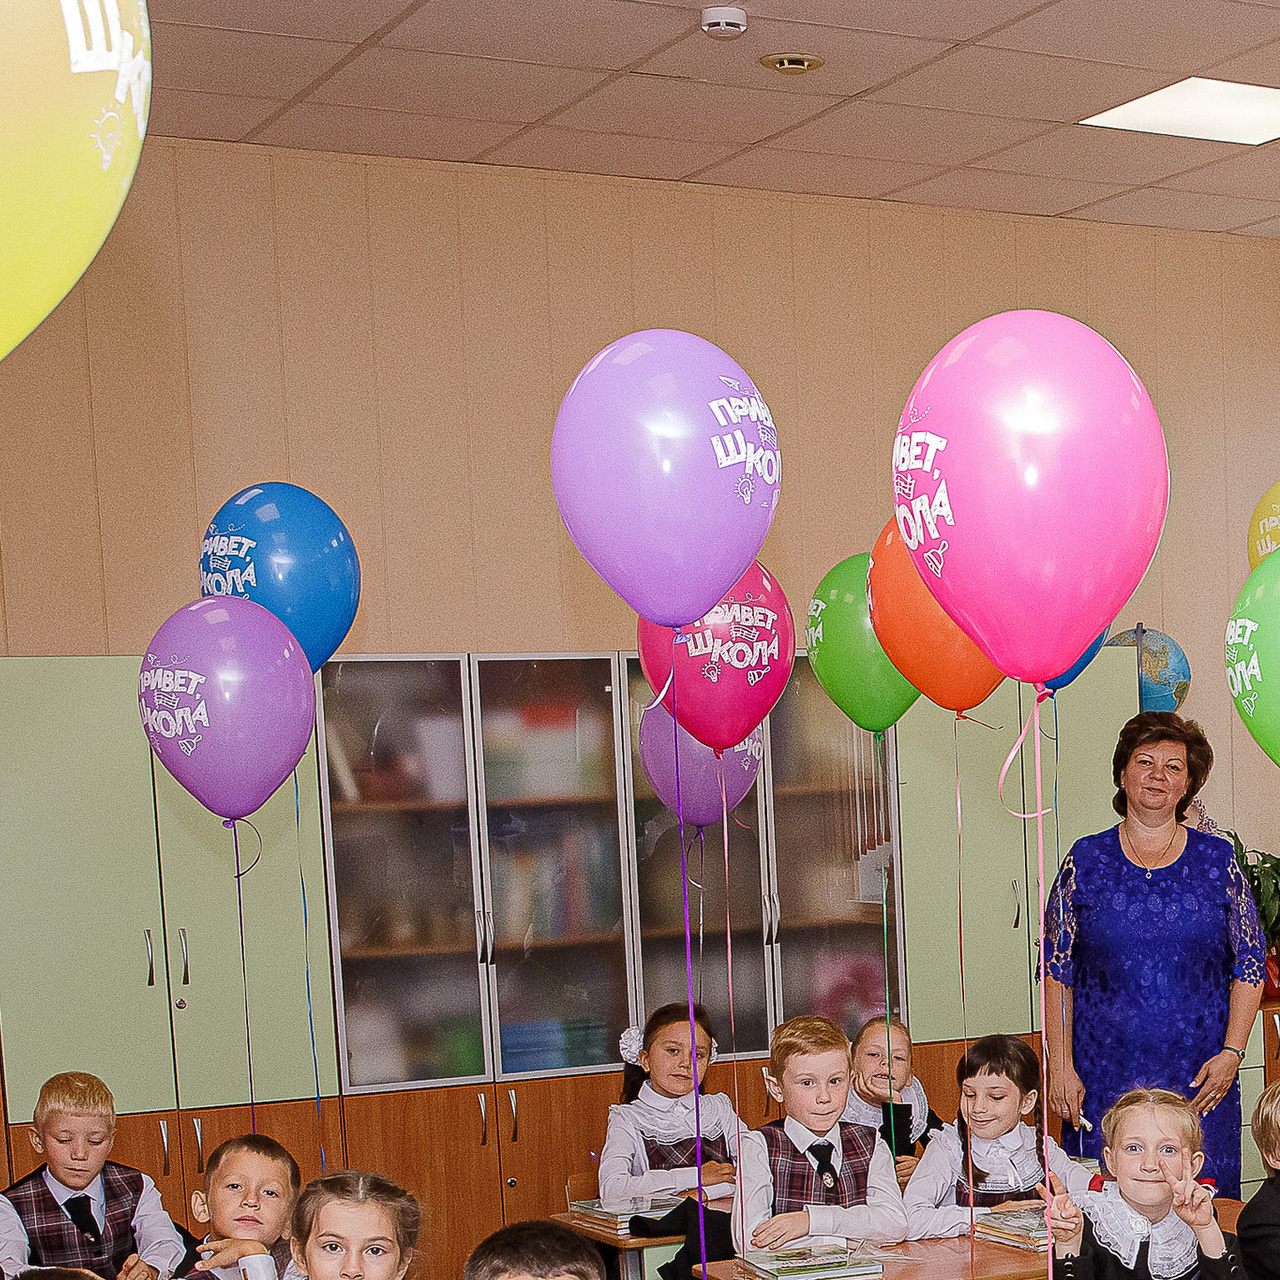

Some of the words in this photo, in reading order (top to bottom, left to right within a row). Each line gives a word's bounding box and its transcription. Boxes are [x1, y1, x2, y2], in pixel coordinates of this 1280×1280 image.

[896, 478, 955, 551] ОЛА
[200, 535, 257, 562] РИВЕТ,
[200, 562, 257, 596] КОЛА
[685, 629, 779, 669] ШКОЛА
[1227, 650, 1262, 698] ОЛА
